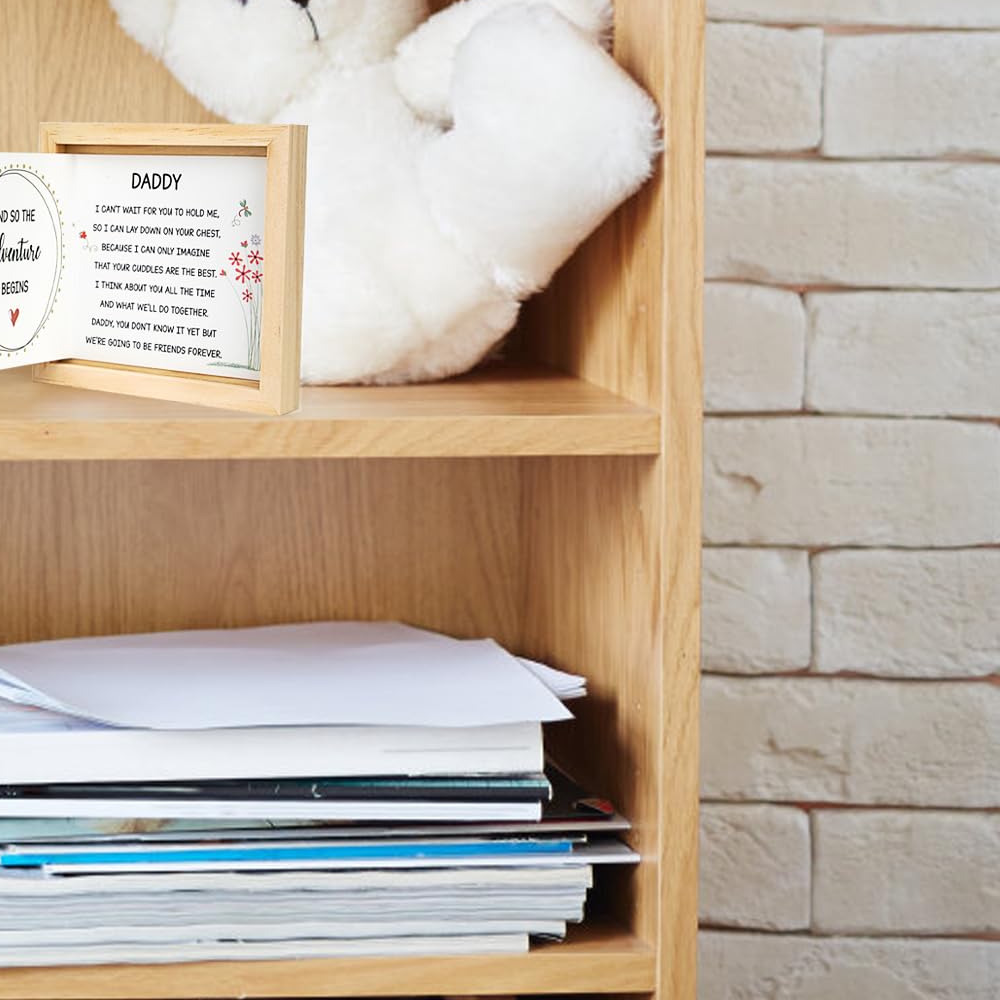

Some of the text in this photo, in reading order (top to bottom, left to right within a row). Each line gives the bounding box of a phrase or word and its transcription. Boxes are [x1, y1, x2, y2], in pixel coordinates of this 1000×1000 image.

[131, 173, 182, 190] DADDY
[10, 210, 20, 222] SO
[22, 209, 36, 222] THE
[95, 205, 100, 213] I
[122, 206, 141, 215] WAIT
[143, 207, 156, 215] FOR
[158, 207, 172, 216] YOU
[174, 208, 184, 216] TO
[185, 208, 204, 217] HOLD
[92, 224, 102, 232] SO
[104, 224, 108, 232] I
[110, 225, 124, 233] CAN
[125, 226, 138, 234] LAY
[140, 226, 161, 235] DOWN
[163, 227, 173, 236] ON
[175, 228, 194, 236] YOUR
[101, 244, 210, 257] BECAUSE I CAN ONLY IMAGINE
[94, 262, 111, 270] THAT
[112, 263, 130, 271] YOUR
[132, 264, 164, 274] CUDDLES
[165, 266, 179, 275] ARE
[181, 268, 195, 276] THE
[1, 280, 29, 295] BEGINS
[101, 281, 122, 290] THINK
[124, 283, 146, 292] ABOUT
[149, 285, 163, 293] YOU
[165, 286, 178, 294] ALL
[180, 287, 194, 296] THE
[196, 288, 215, 298] TIME
[100, 300, 114, 308] AND
[116, 301, 134, 310] WHAT
[159, 305, 169, 313] DO
[116, 320, 129, 329] YOU
[153, 324, 174, 334] KNOW
[176, 326, 184, 335] IT
[187, 327, 200, 336] YET
[202, 328, 217, 337] BUT
[108, 338, 130, 348] GOING
[133, 341, 141, 349] TO
[143, 342, 152, 350] BE
[154, 343, 186, 354] FRIENDS
